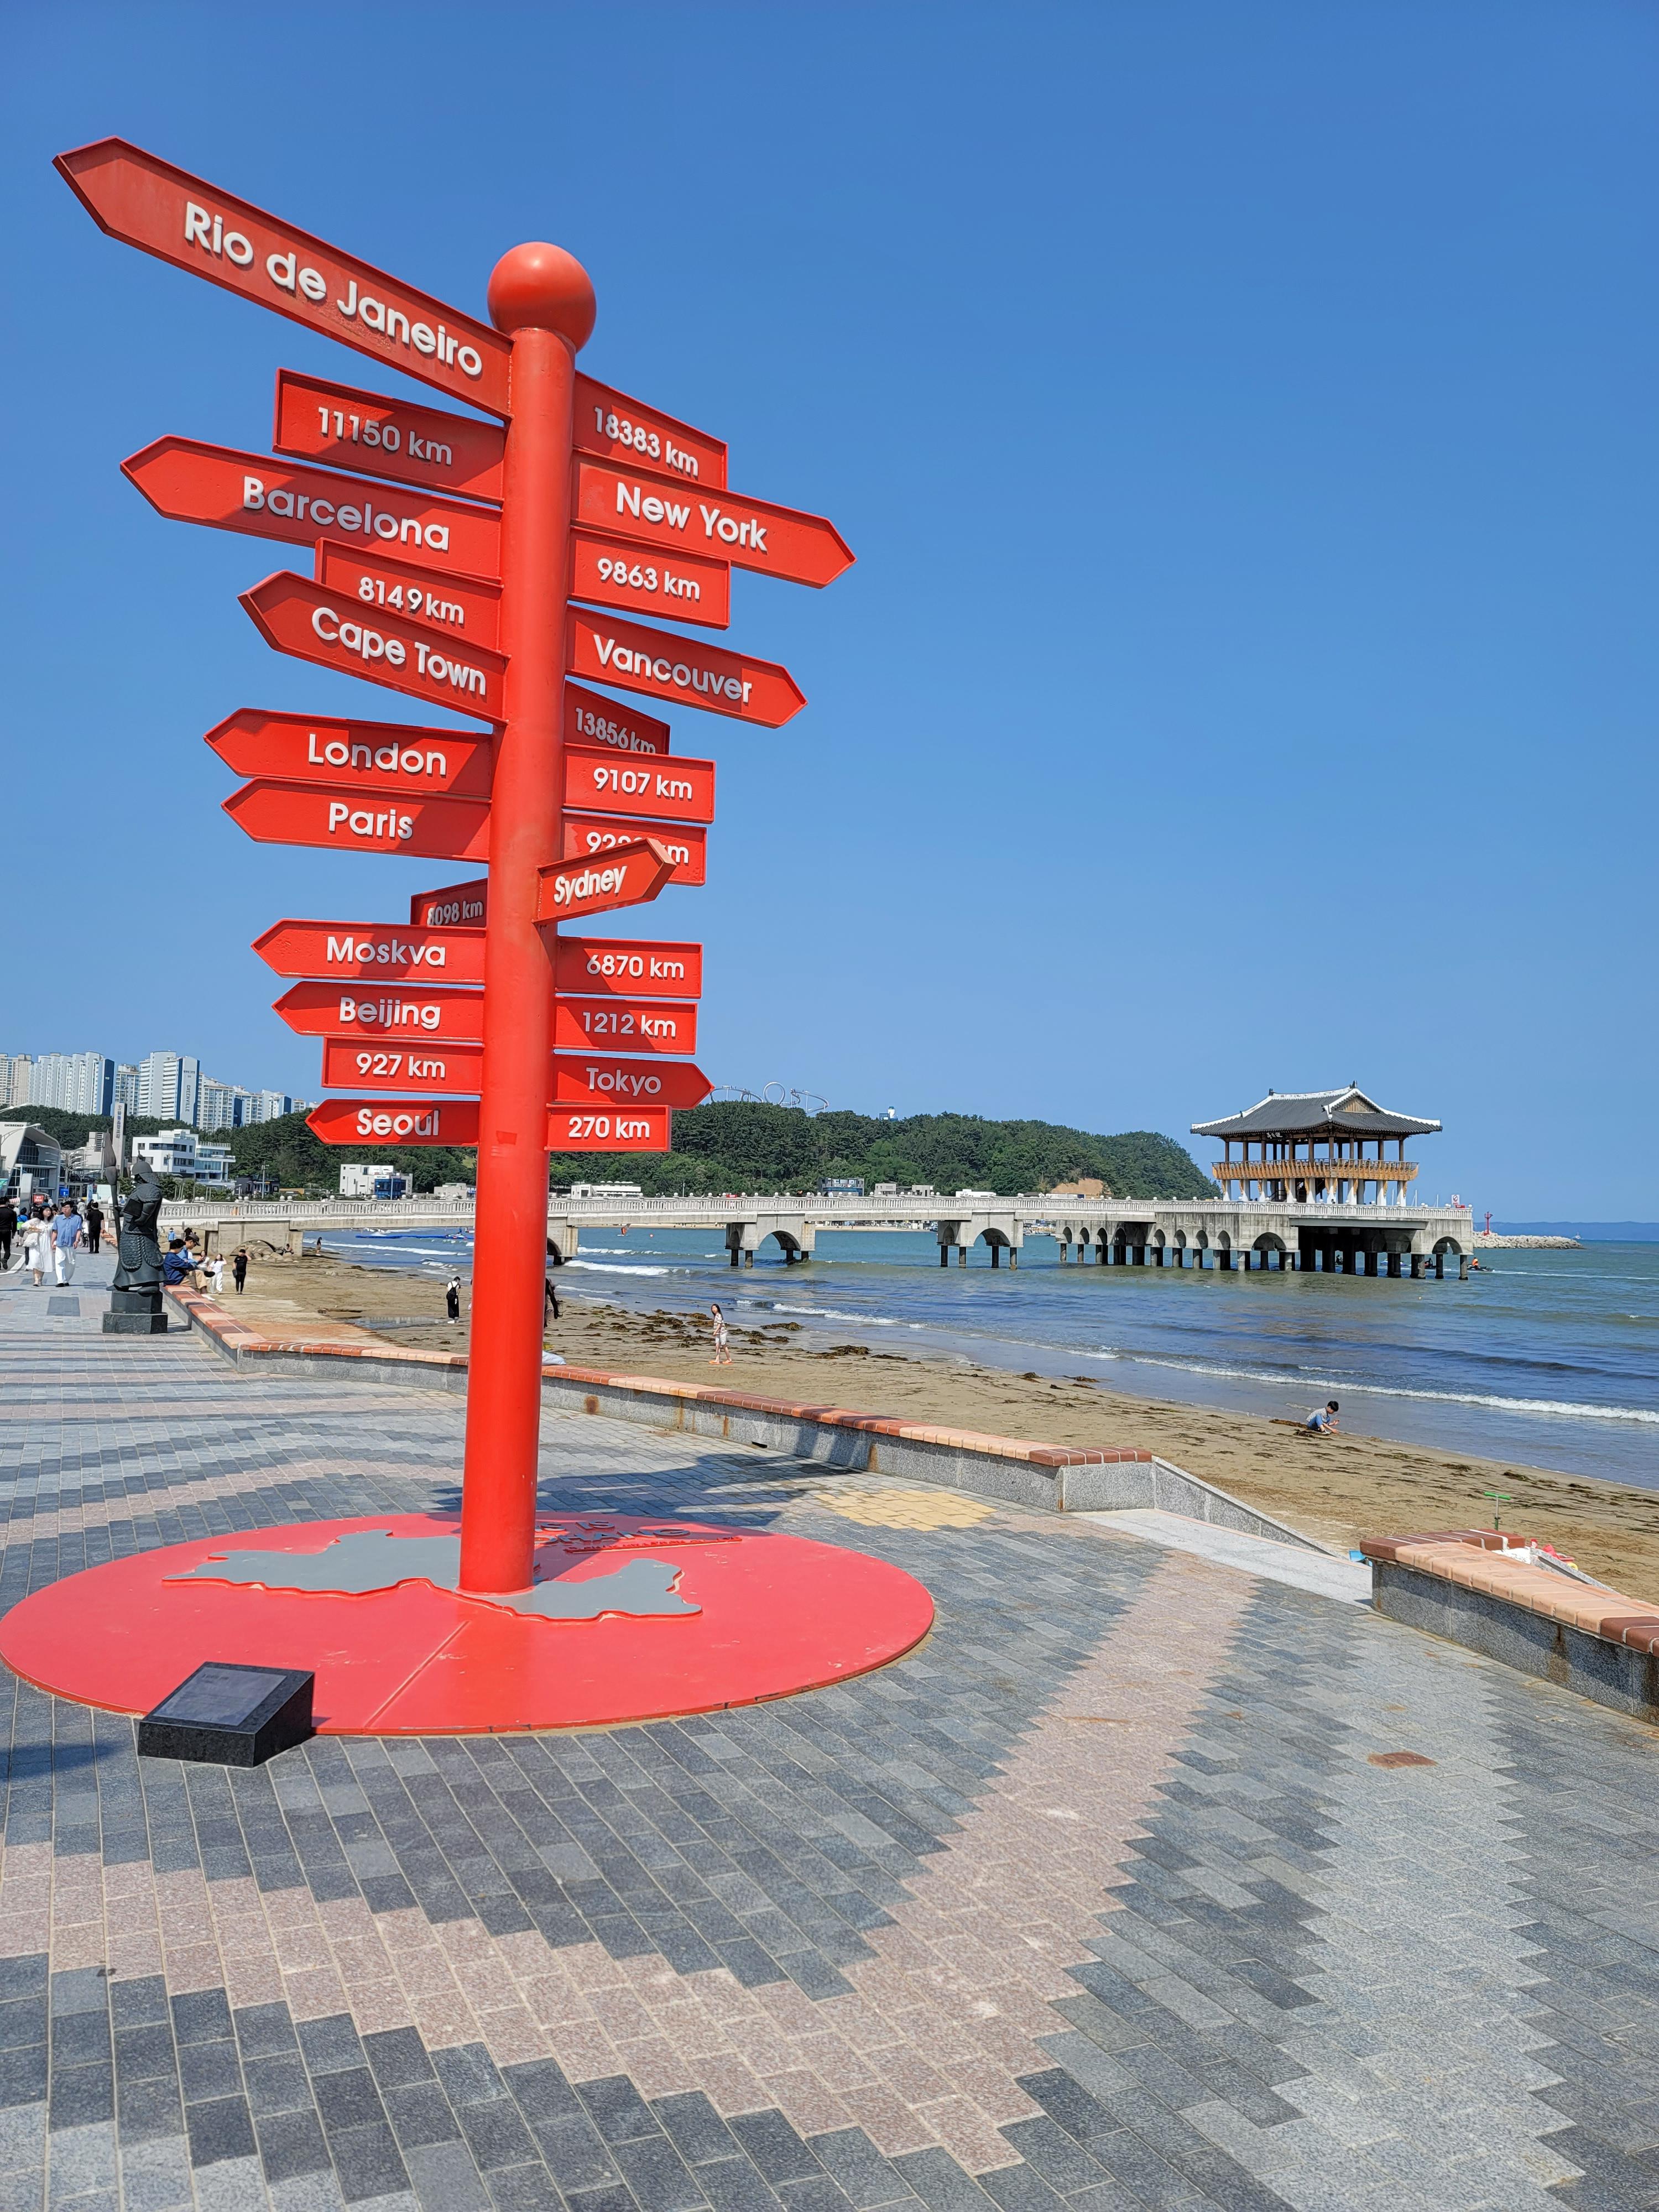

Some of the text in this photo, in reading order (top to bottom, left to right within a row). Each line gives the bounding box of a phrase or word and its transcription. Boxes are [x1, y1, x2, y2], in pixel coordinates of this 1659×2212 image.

[185, 201, 482, 375] Rio de Janeiro
[319, 407, 452, 465] 11150 km
[594, 407, 698, 476] 18383 km
[244, 476, 449, 551] Barcelona
[617, 482, 767, 551] New York
[597, 557, 700, 599] 9863 km
[358, 577, 464, 624] 8149 km
[311, 607, 486, 695] Cape Town
[593, 634, 752, 703] Vancouver
[576, 708, 629, 749] 13856
[309, 733, 446, 775] London
[593, 768, 692, 799] 9107 km
[328, 802, 413, 839] Paris
[586, 832, 690, 864] 92 m
[554, 865, 627, 905] Sydney
[427, 901, 483, 926] 8098 km
[327, 936, 446, 966] Moskva
[587, 954, 684, 978] 6870 km
[340, 997, 441, 1030] Beijing
[583, 1012, 676, 1037] 1212 km
[356, 1053, 445, 1078] 927 km
[586, 1067, 661, 1096] Tokyo
[357, 1108, 439, 1136] Seoul
[568, 1117, 650, 1139] 270 km
